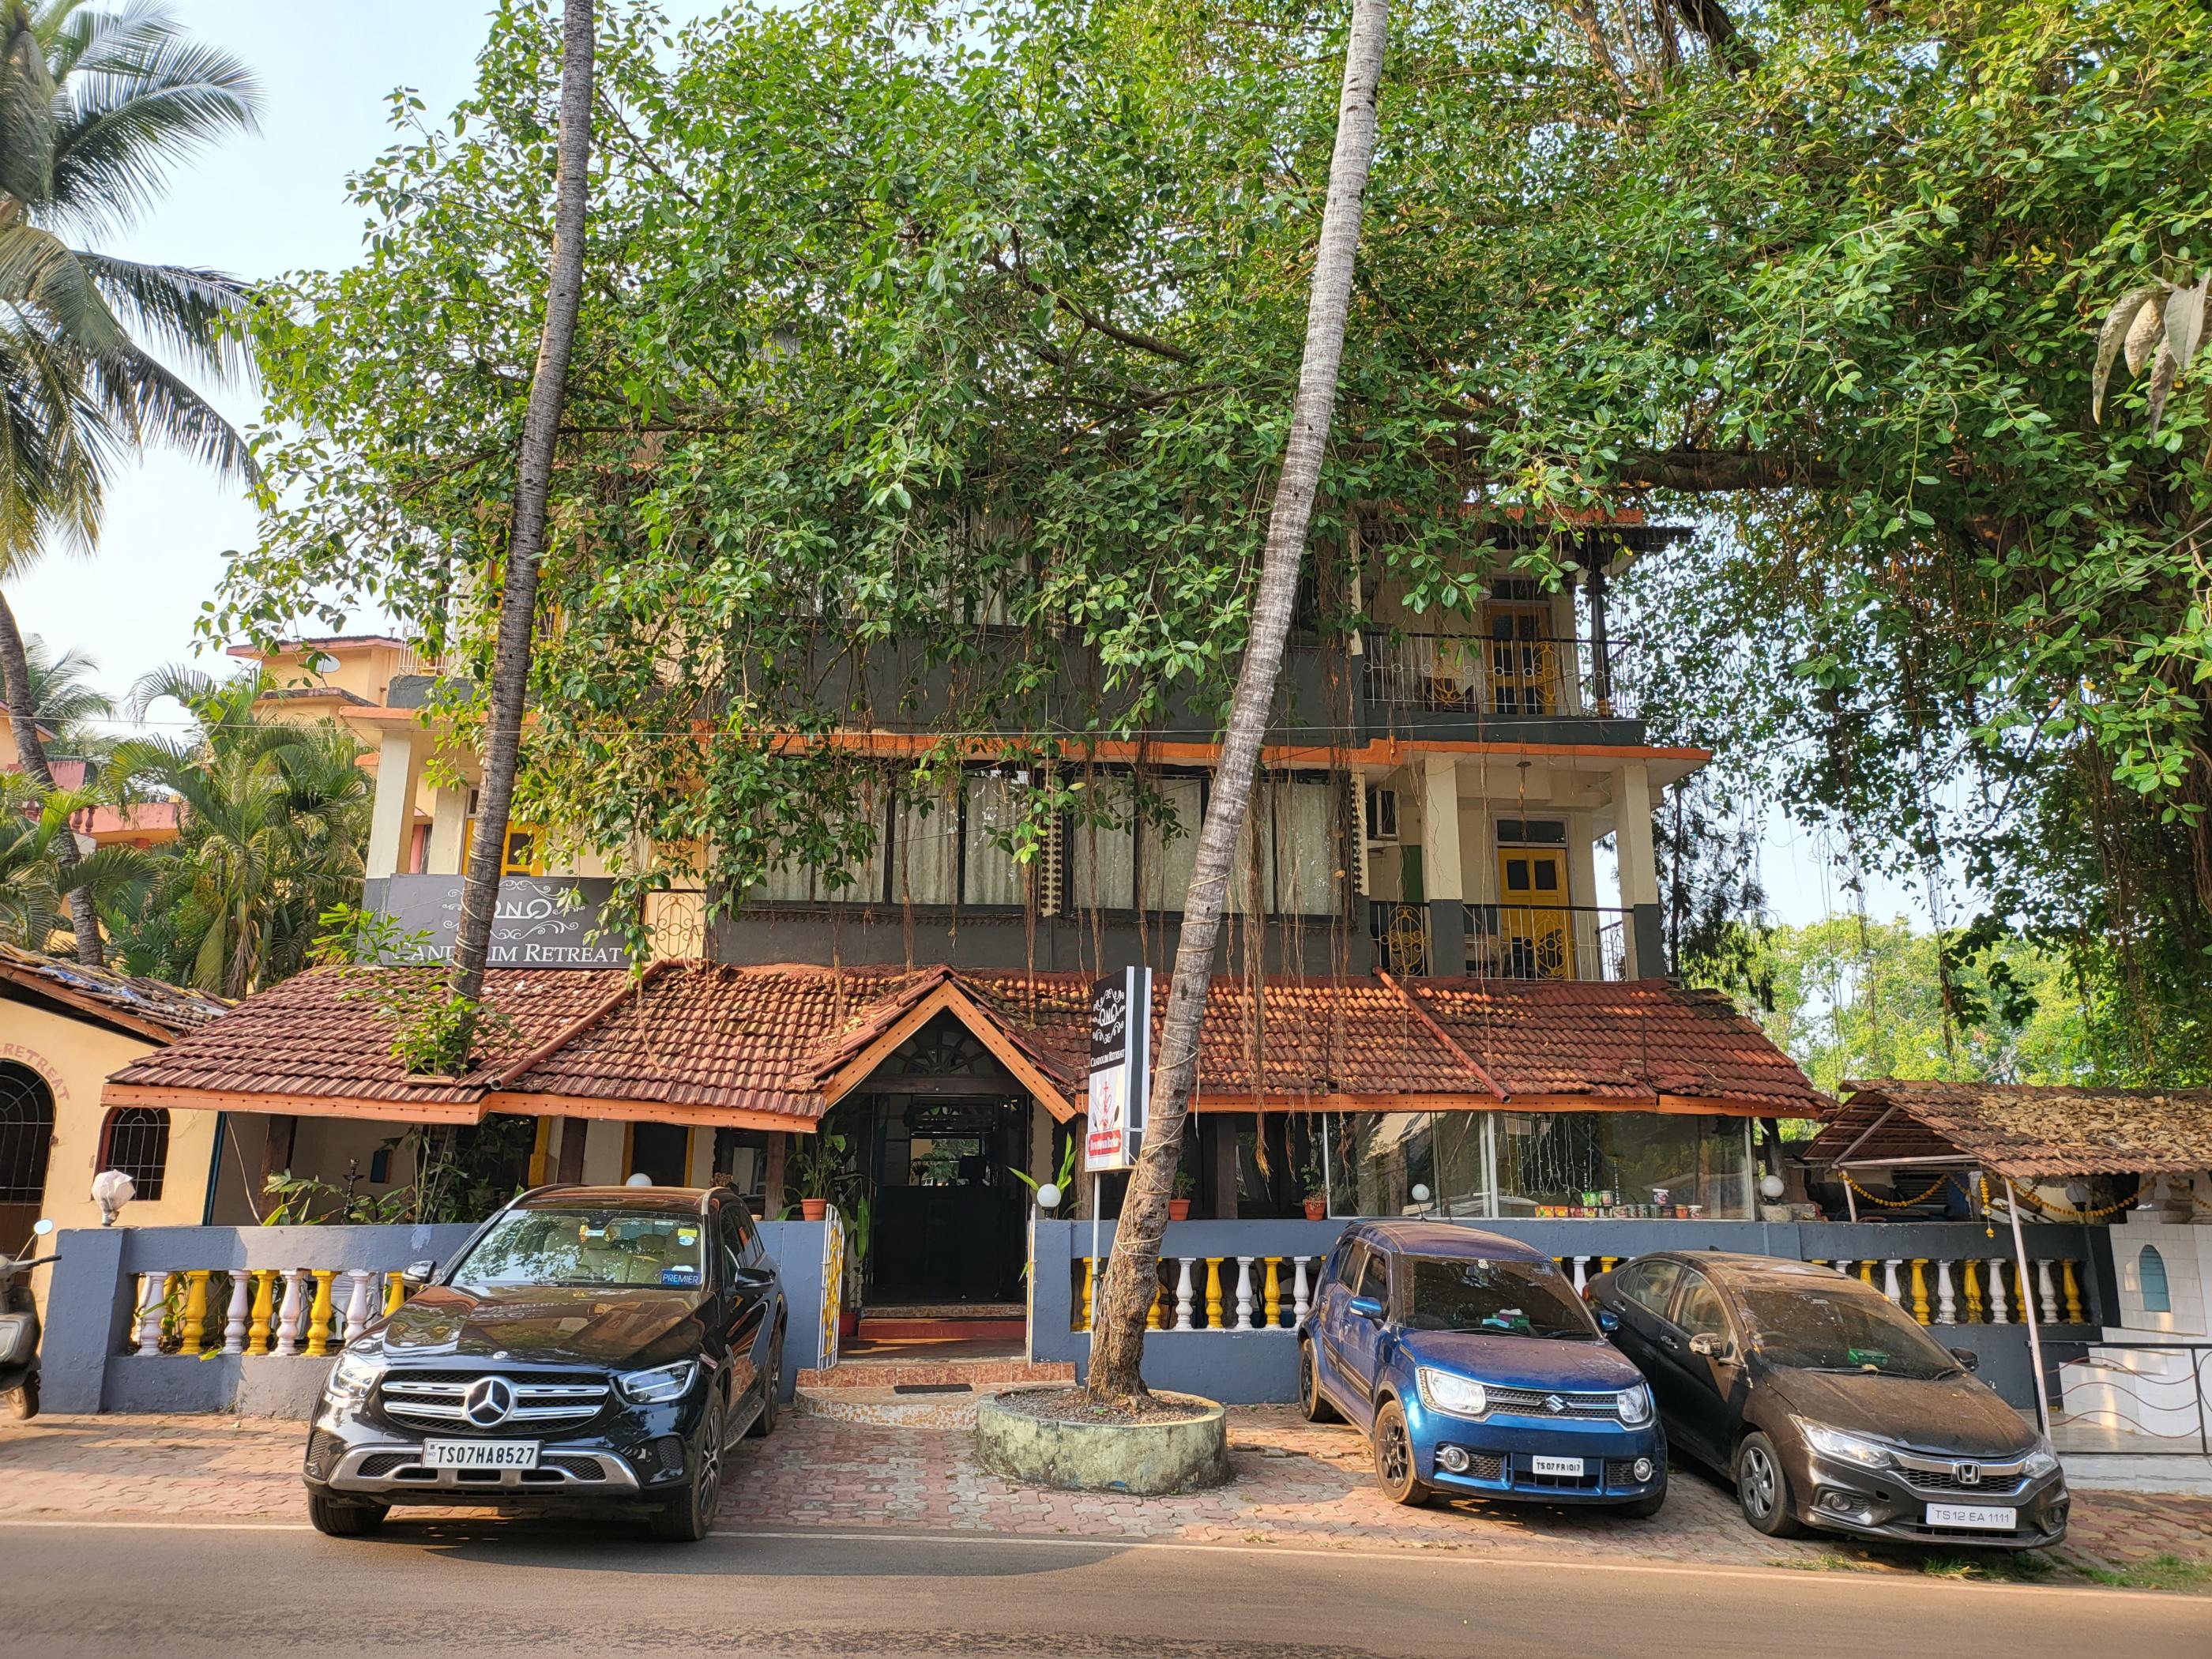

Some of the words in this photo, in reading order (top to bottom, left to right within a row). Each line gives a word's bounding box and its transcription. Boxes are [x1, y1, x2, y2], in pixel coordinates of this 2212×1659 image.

[524, 943, 623, 962] RETREAT
[3, 1043, 70, 1100] RETREAT
[662, 1273, 699, 1284] PREMIER
[438, 1446, 535, 1465] TS07HA8527
[1969, 1512, 1985, 1522] EA
[1988, 1514, 2009, 1523] 1111
